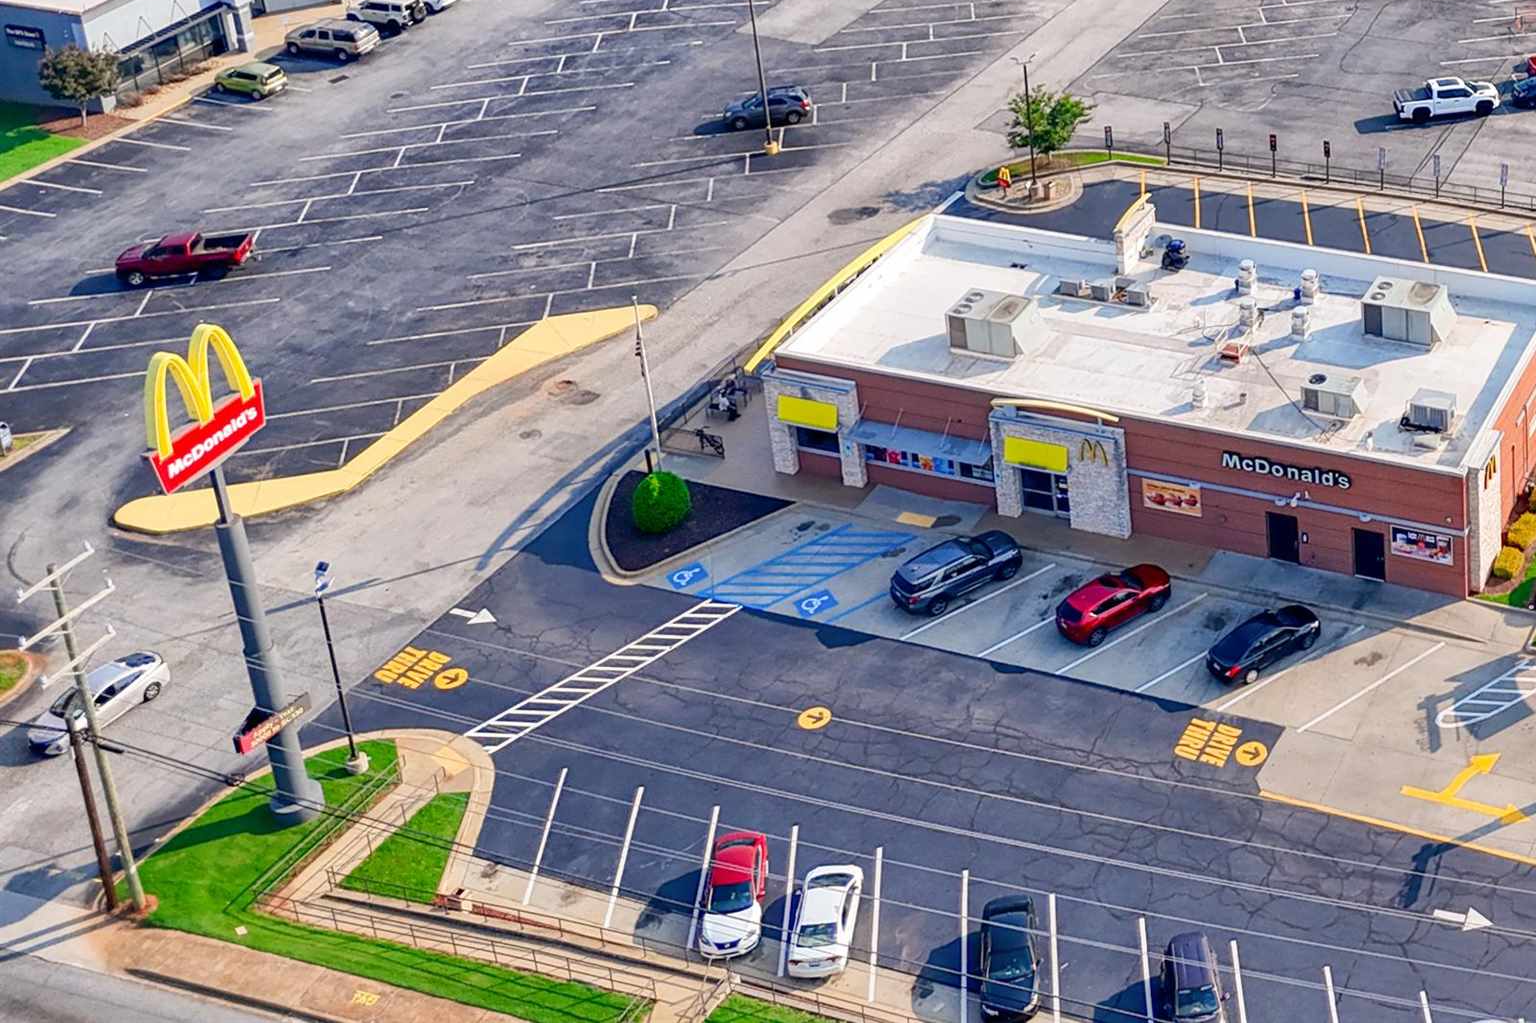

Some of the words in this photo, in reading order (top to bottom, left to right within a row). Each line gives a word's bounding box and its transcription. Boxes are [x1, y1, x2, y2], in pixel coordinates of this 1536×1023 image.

[167, 406, 258, 479] McDonald's
[1221, 452, 1351, 489] McDonald's
[373, 645, 429, 684] THRU
[396, 650, 453, 689] DRIVE
[1174, 717, 1217, 761] THRU
[1199, 723, 1242, 768] DRIVE
